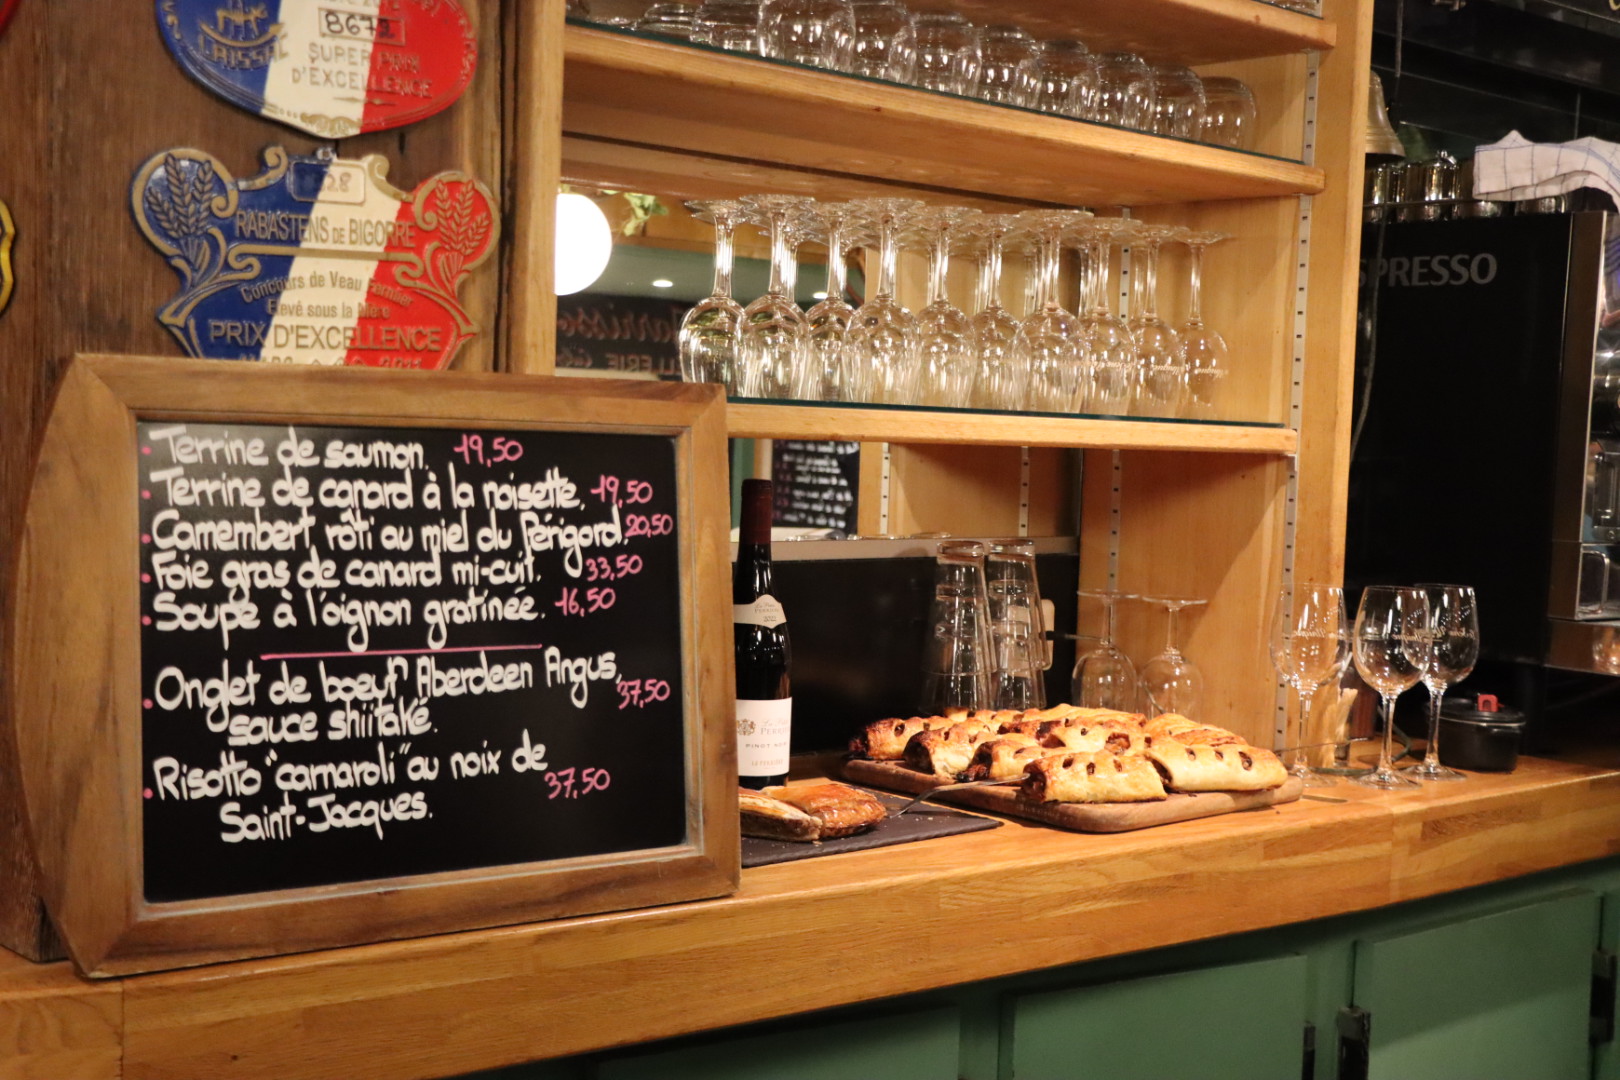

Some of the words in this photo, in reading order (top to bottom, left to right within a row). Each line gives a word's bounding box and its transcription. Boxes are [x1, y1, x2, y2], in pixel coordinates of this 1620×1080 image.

[308, 42, 372, 66] SUPER
[377, 51, 420, 73] PRIX
[292, 67, 433, 97] D'EXCELLENCE
[235, 210, 330, 243] RABASTENS
[349, 218, 416, 247] BIGORRE
[240, 275, 305, 303] Concours
[309, 271, 325, 288] de
[329, 271, 363, 290] Veau
[367, 278, 414, 307] Fermier
[307, 304, 338, 318] sous
[342, 302, 353, 318] la
[207, 319, 268, 347] PRIX
[273, 323, 442, 351] D'EXCELLENCE
[149, 425, 269, 466] Terrine
[276, 425, 320, 467] de
[453, 434, 524, 467] 19,50
[150, 466, 265, 507] Terrine
[271, 464, 314, 507] de
[318, 466, 413, 509] canard
[422, 471, 441, 510] à
[448, 461, 475, 510] la
[590, 474, 653, 508] 19,50
[152, 506, 316, 551] Camembert
[324, 507, 374, 550] rôti
[380, 524, 413, 551] au
[421, 509, 469, 552] miel
[476, 507, 512, 550] du
[624, 513, 673, 538] 20,50
[151, 550, 213, 590] Foie
[221, 558, 291, 604] gras
[297, 545, 340, 589] de
[345, 548, 442, 588] canard
[585, 554, 643, 582] 33,50
[153, 590, 261, 651] Soupe
[272, 588, 297, 629] à
[306, 588, 412, 653] l'oignon
[554, 587, 616, 617] 16,50
[154, 657, 262, 733] Onglet
[268, 660, 312, 705] de
[416, 650, 533, 698] Aberdeen
[616, 679, 671, 710] 37,50
[228, 710, 319, 746] sauce
[153, 750, 262, 801] Risotto
[407, 755, 439, 781] au
[450, 740, 501, 779] noix
[511, 728, 548, 773] de
[544, 767, 611, 799] 37,50
